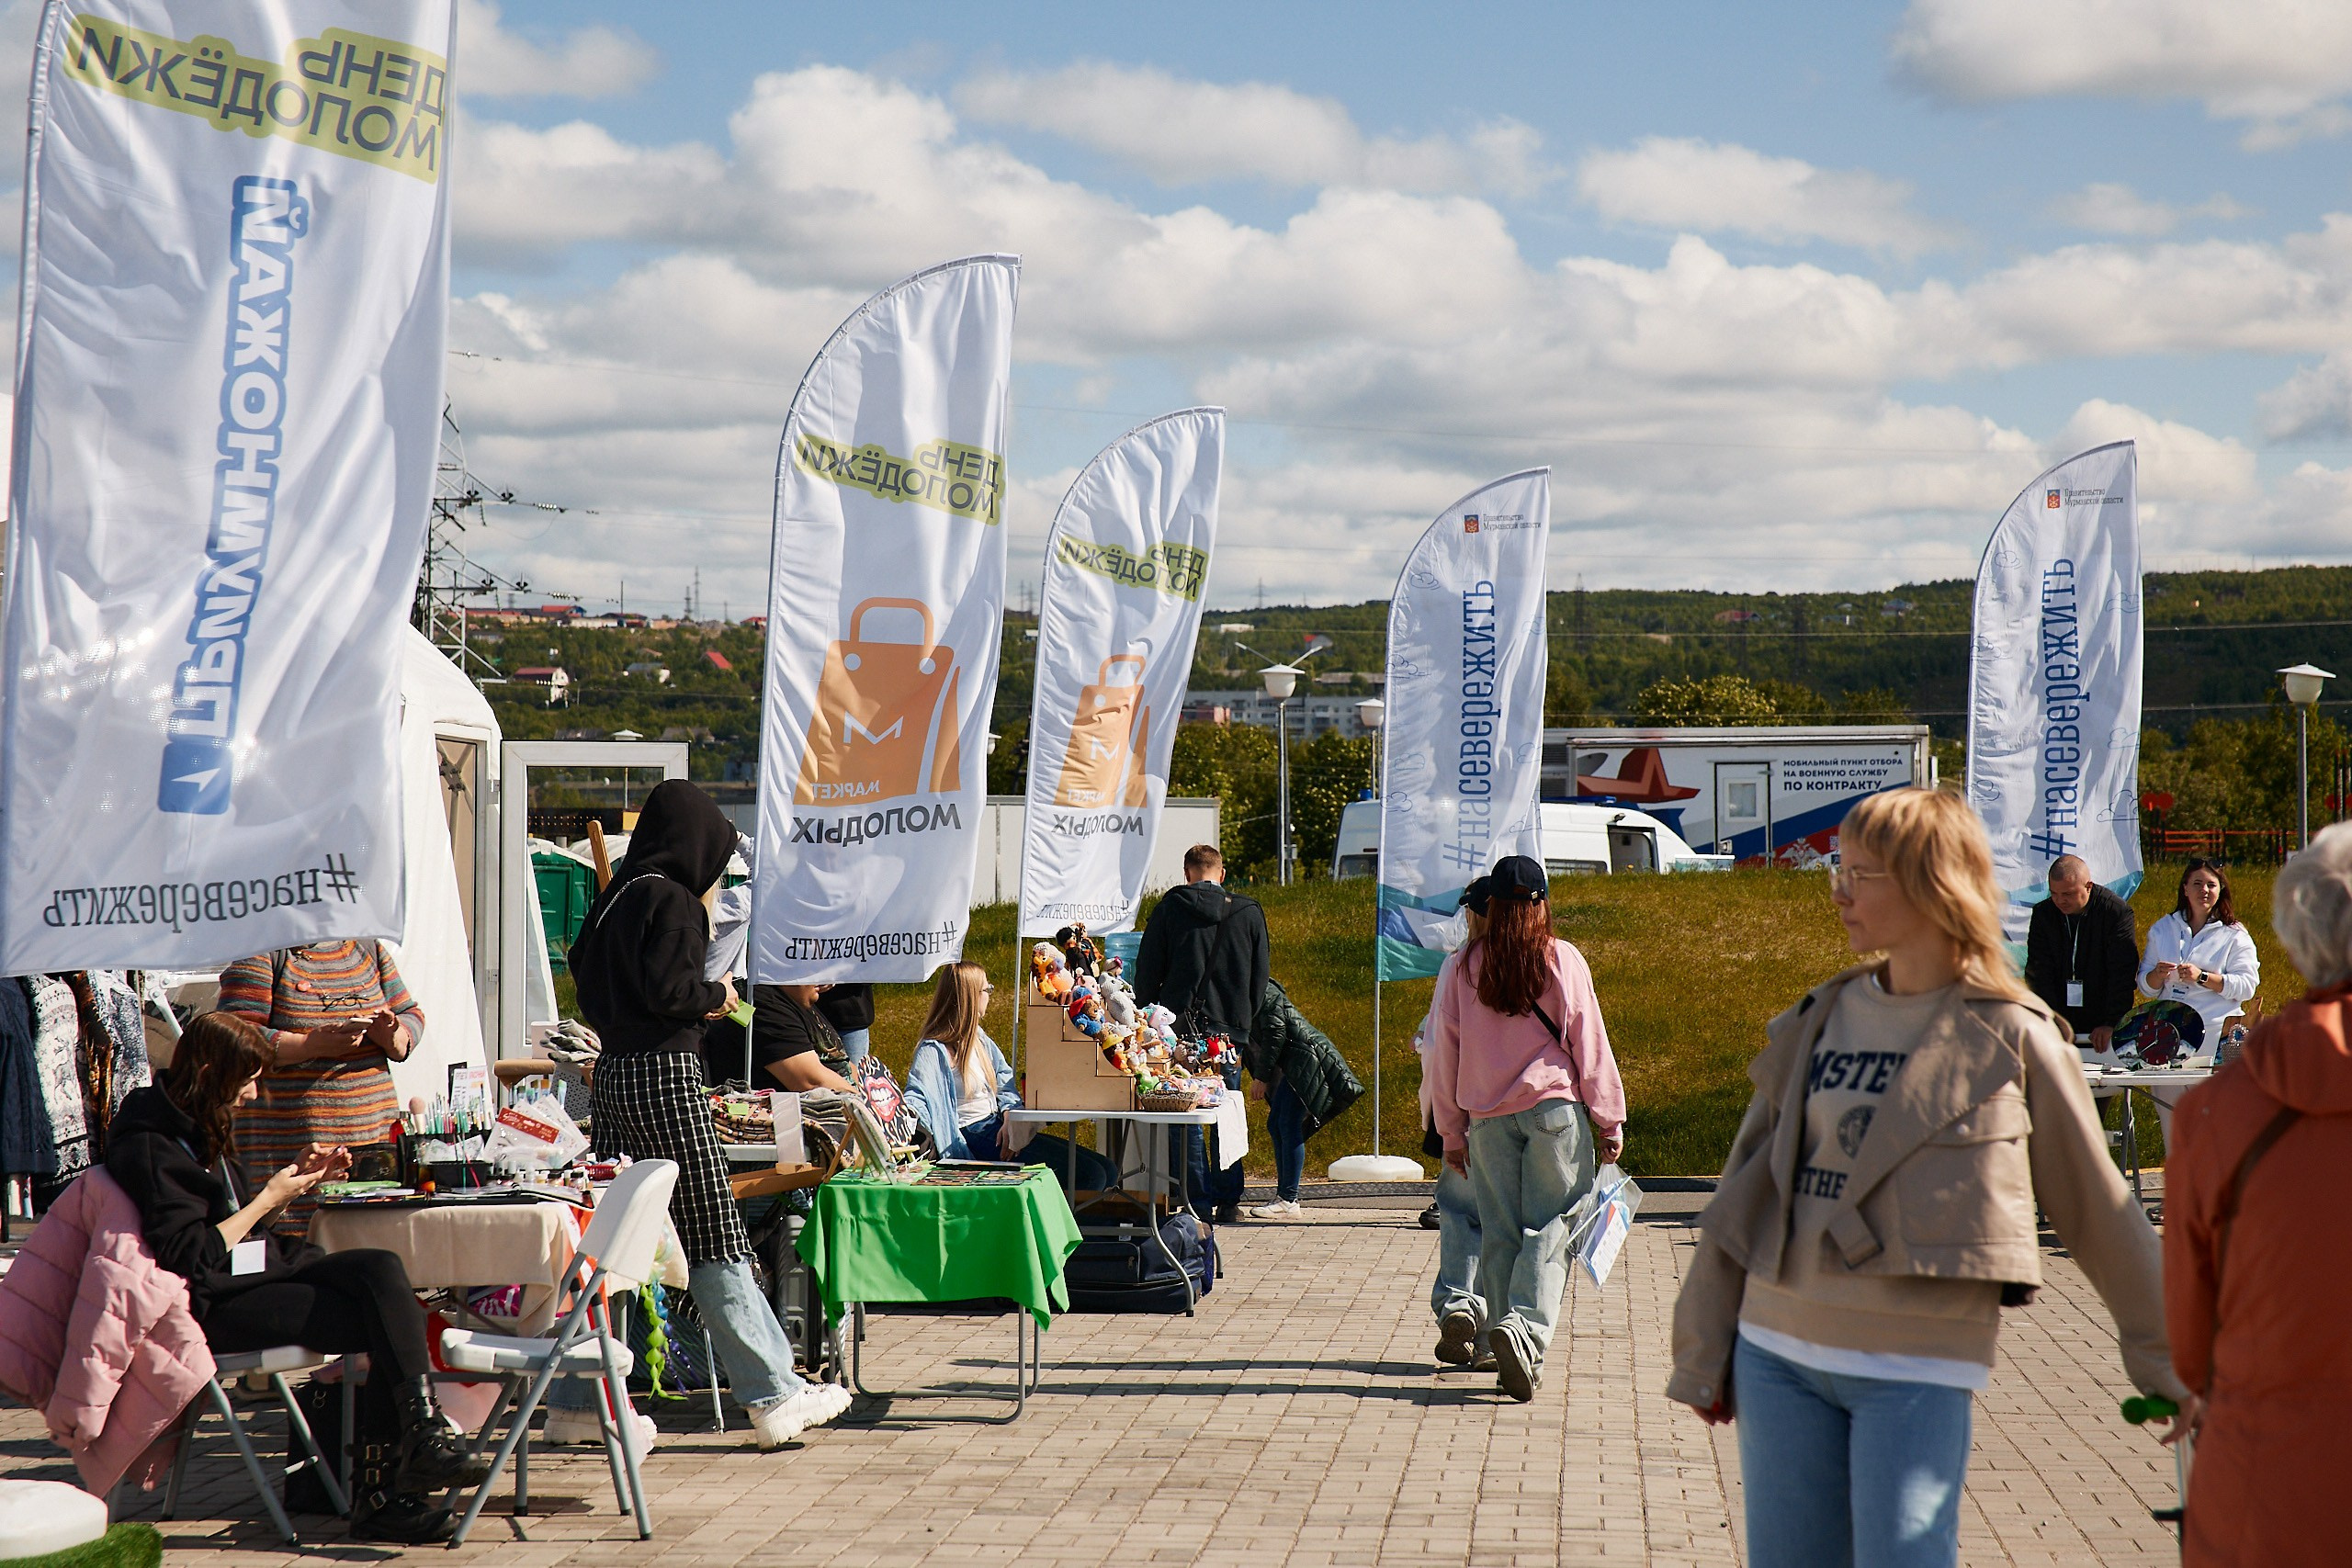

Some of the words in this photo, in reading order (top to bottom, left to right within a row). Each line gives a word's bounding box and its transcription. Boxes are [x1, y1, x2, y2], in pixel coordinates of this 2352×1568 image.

[1783, 758, 1838, 767] МОБИЛЬНЫЙ
[1840, 758, 1868, 766] ПУНКТ
[1870, 758, 1903, 766] ОТБОРА
[1849, 769, 1888, 777] СЛУЖБУ
[1783, 781, 1803, 791] ПО
[1806, 780, 1883, 791] КОНТРАКТУ
